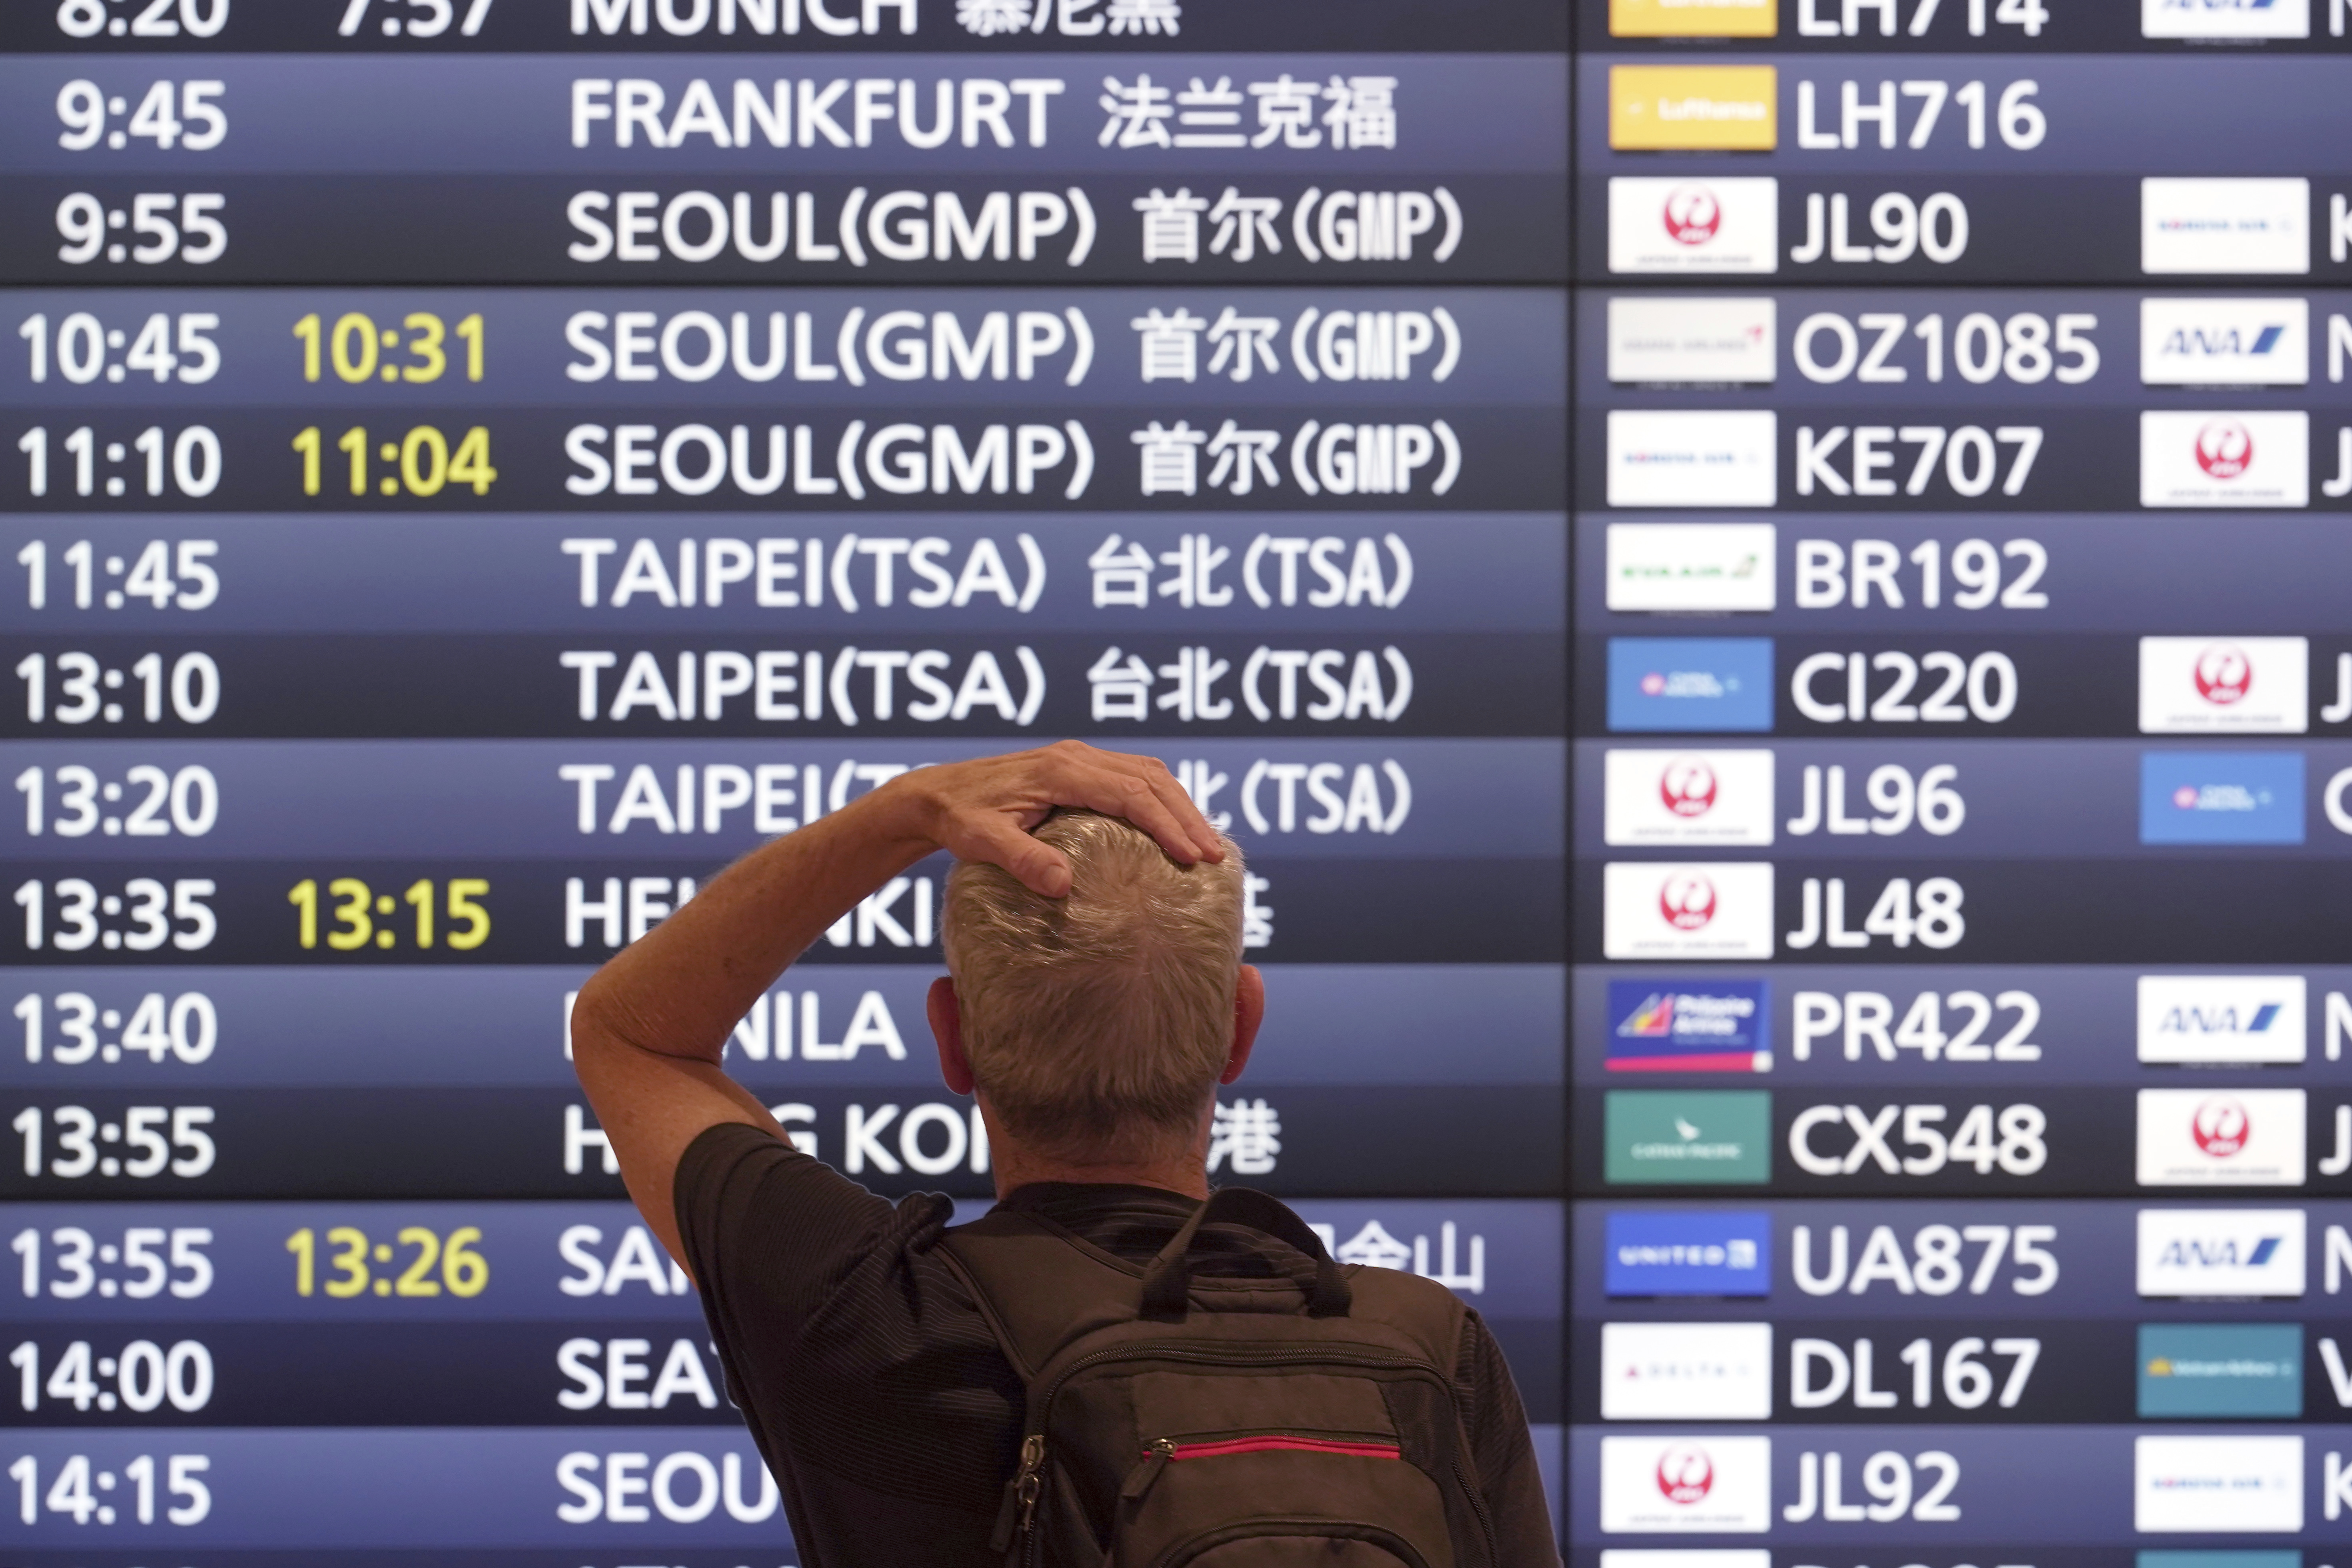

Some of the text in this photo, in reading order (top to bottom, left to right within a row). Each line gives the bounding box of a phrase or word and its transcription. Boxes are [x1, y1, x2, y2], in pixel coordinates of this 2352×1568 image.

[57, 80, 227, 150] 9:45
[571, 74, 1398, 149] FRANKFURT 法兰克福
[1798, 80, 2046, 150] LH716
[57, 193, 227, 263] 9:55
[568, 188, 1462, 266] SEOUL(GMP) 首尔(GMP)
[1791, 193, 1968, 263] JL90
[20, 313, 220, 383] 10:45
[294, 313, 483, 382] 10:31
[565, 307, 1461, 386] SEOUL(GMP) 首尔(GMP)
[1794, 313, 2100, 383] OZ1085
[19, 426, 221, 496] 11:10
[294, 426, 496, 495] 11:04
[565, 420, 1461, 499] SEOUL(GMP) 首尔(GMP)
[1797, 426, 2043, 496] KE707
[18, 540, 219, 610] 11:45
[561, 534, 1413, 612] TAIPEI(TSA) 台北(TSA)
[1796, 539, 2048, 609] BR192
[17, 652, 219, 723] 13:10
[560, 647, 1412, 725] TAIPEI(TSA) 台北(TSA)
[1792, 652, 2017, 722] CI220
[16, 766, 218, 836] 13:20
[1175, 759, 1412, 835] 北(TSA)
[1787, 764, 1965, 835] JL96
[15, 879, 216, 949] 13:35
[289, 879, 490, 949] 13:15
[1786, 878, 1964, 948] JL48
[14, 992, 217, 1063] 13:40
[564, 990, 907, 1060] NILA
[1793, 990, 2041, 1061] PR422
[13, 1106, 215, 1176] 13:55
[1206, 1098, 1281, 1174] 港
[1790, 1104, 2046, 1174] CX548
[11, 1228, 213, 1298] 13:55
[286, 1227, 489, 1297] 13:26
[559, 1220, 1485, 1296] SA 金山
[1793, 1225, 2058, 1295] UA875
[10, 1340, 214, 1411] 14:00
[556, 1338, 721, 1410] SEA
[1791, 1338, 2039, 1408] DL167
[9, 1455, 210, 1525] 14:15
[556, 1451, 782, 1523] SEOU
[1783, 1451, 1960, 1522] JL92
